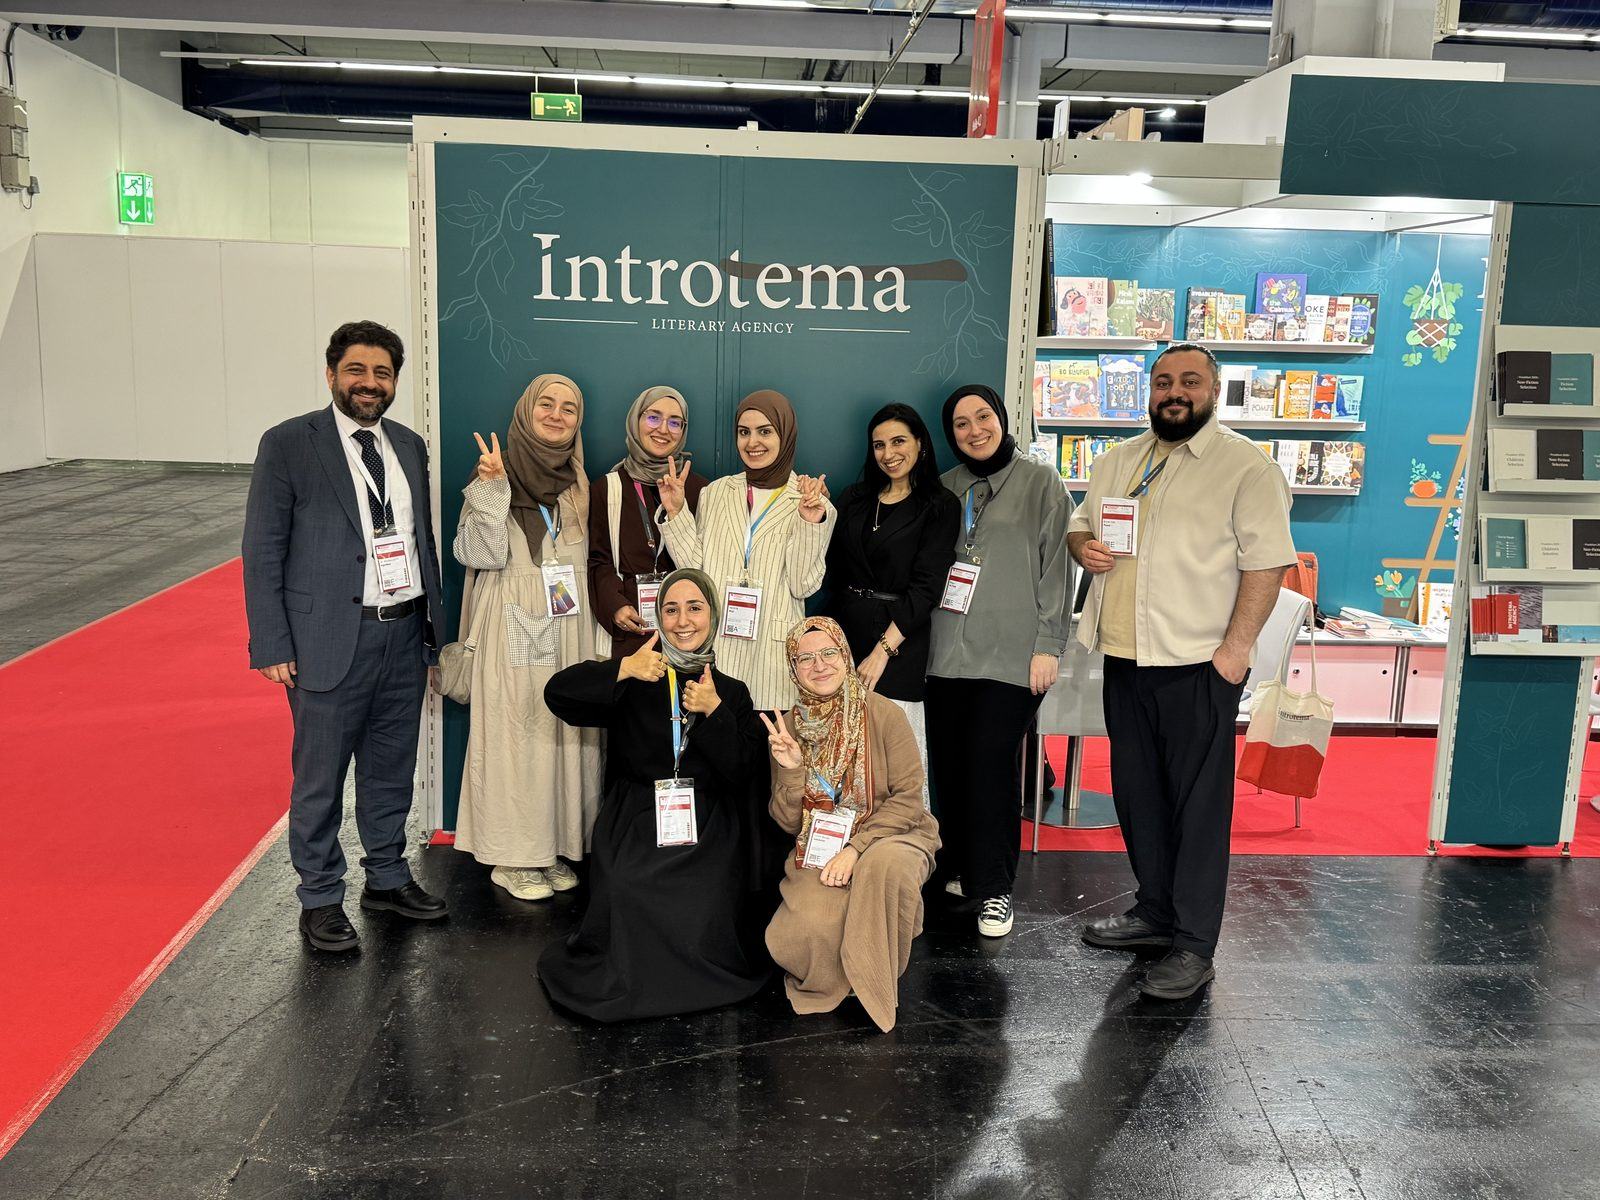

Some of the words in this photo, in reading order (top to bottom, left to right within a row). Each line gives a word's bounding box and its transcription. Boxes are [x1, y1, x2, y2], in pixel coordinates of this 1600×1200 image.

[533, 232, 911, 313] Introtema
[651, 318, 726, 333] LITERARY
[732, 321, 795, 334] AGENCY
